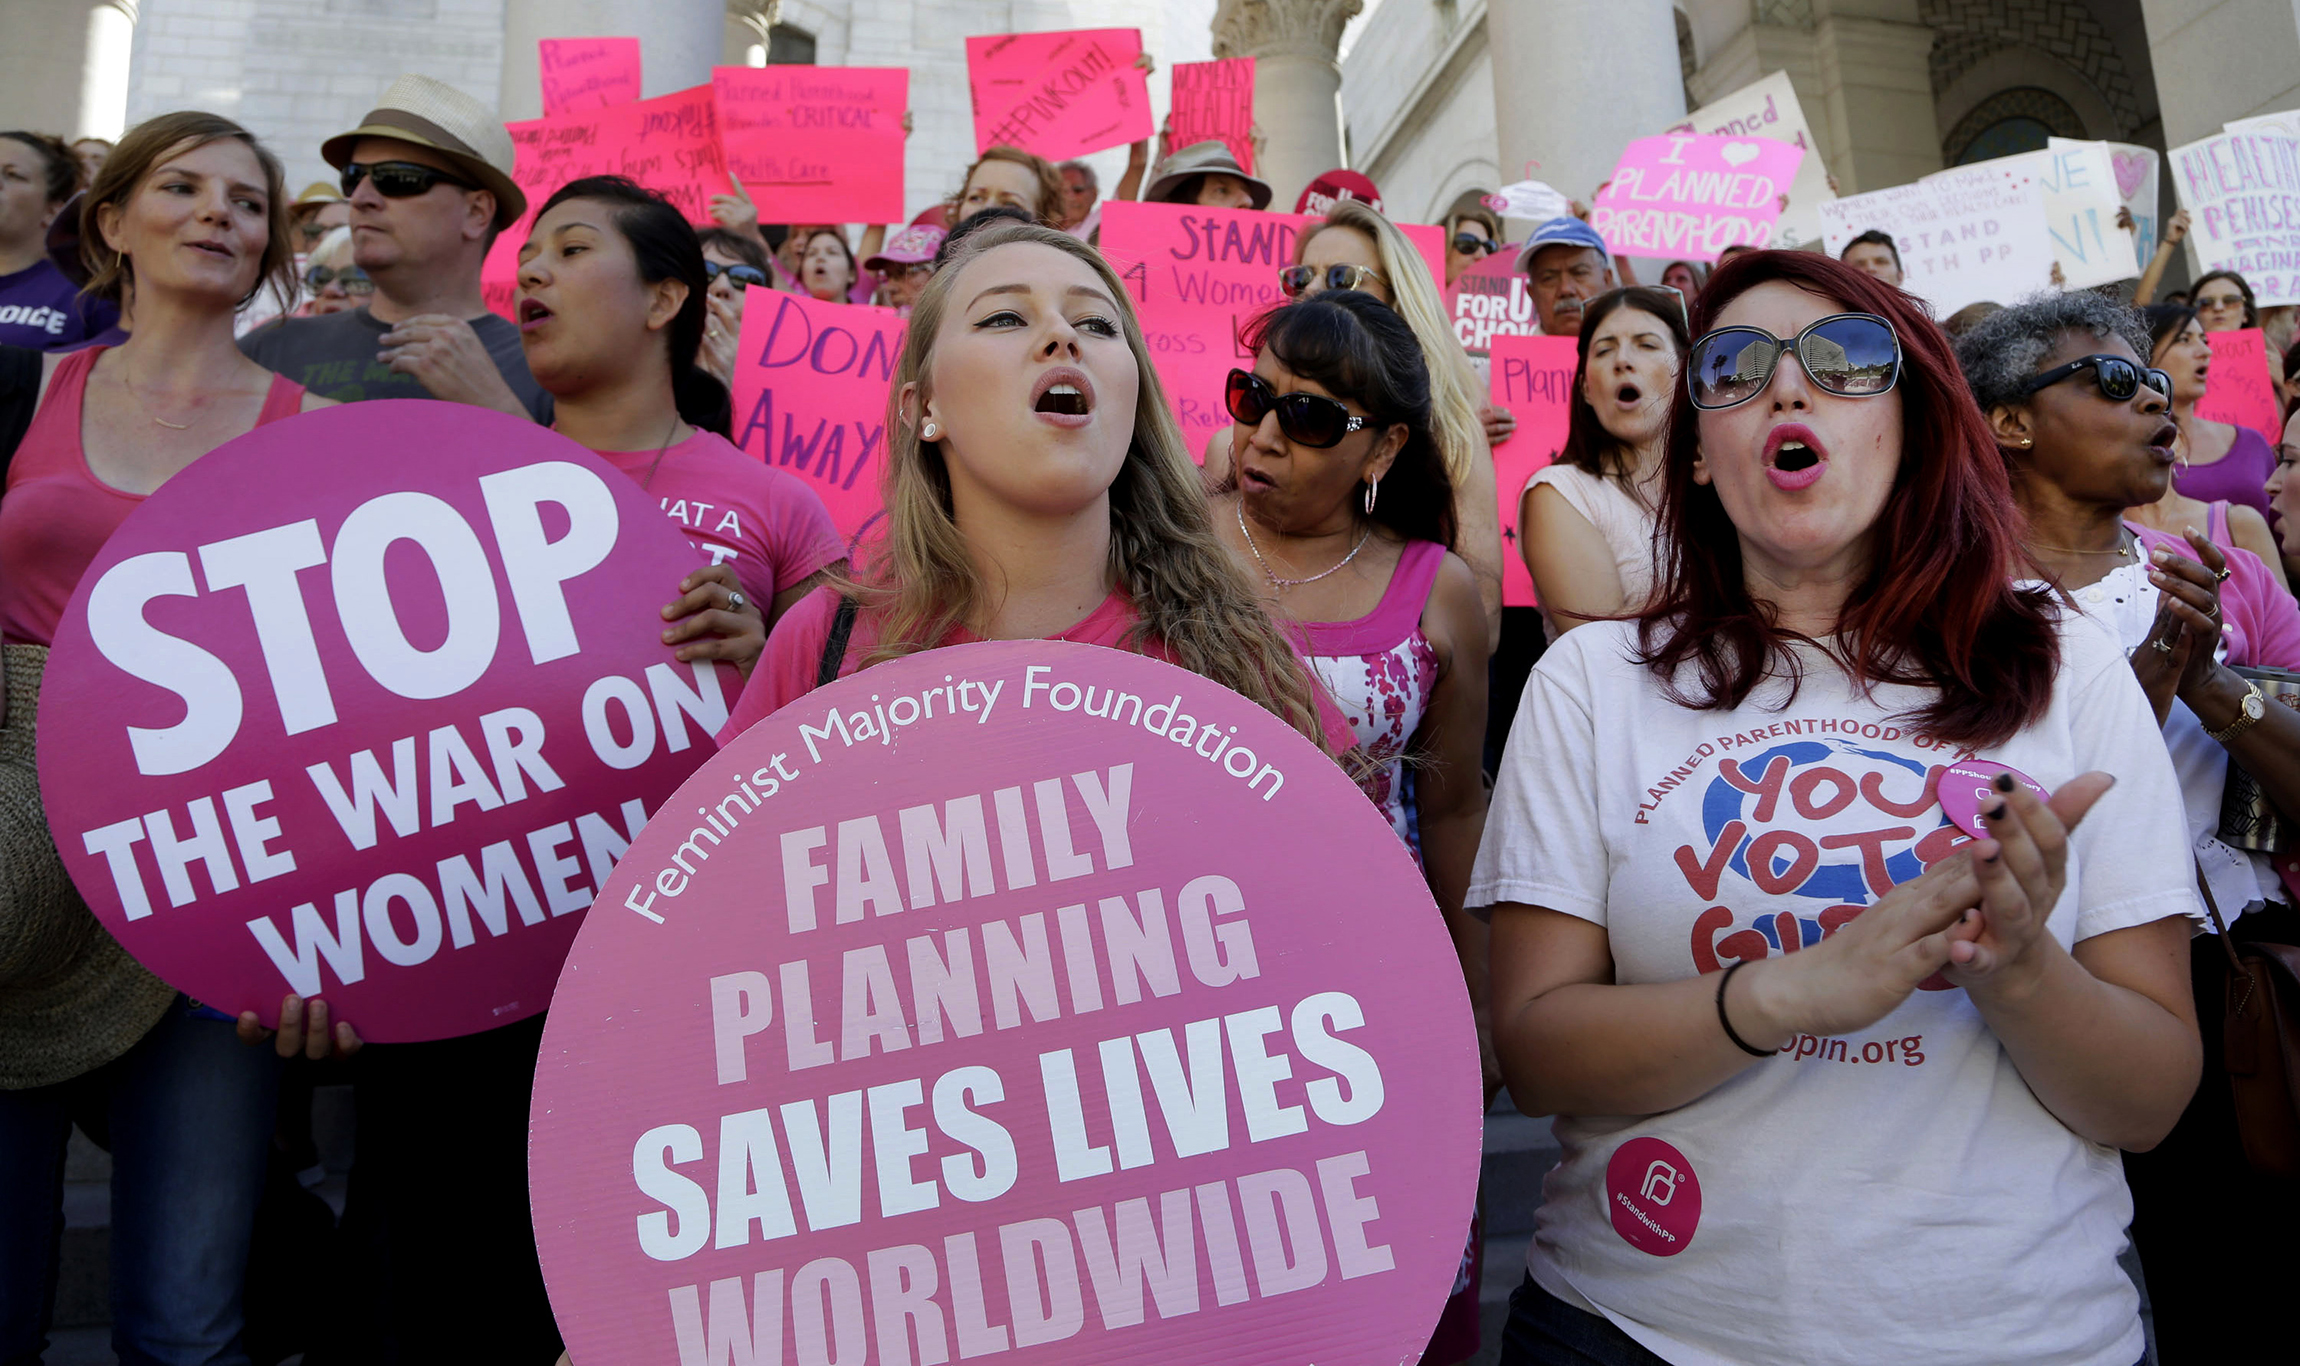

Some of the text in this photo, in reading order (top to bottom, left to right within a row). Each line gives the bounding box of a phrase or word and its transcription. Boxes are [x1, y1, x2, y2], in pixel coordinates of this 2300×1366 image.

[1608, 166, 1775, 210] PLANNED
[1657, 137, 1695, 165] I
[1897, 219, 2001, 254] STAND
[0, 304, 68, 335] OICE
[1455, 293, 1508, 320] FOR
[1460, 274, 1509, 294] STAND
[738, 388, 883, 491] AWAY
[660, 497, 742, 538] AT A
[87, 461, 619, 776] STOP
[82, 658, 730, 922] THE WAR ON
[624, 666, 1285, 925] Feminist Majority Foundation
[1634, 743, 1715, 825] PLANNED
[1718, 755, 1950, 823] YOU
[780, 763, 1134, 934] FAMILY
[246, 797, 648, 1000] WOMEN
[709, 876, 1261, 1085] PLANNING
[633, 992, 1385, 1261] SAVES LIVES
[668, 1150, 1395, 1366] WORLDWIDE
[1617, 1191, 1676, 1243] #StandwithPP
